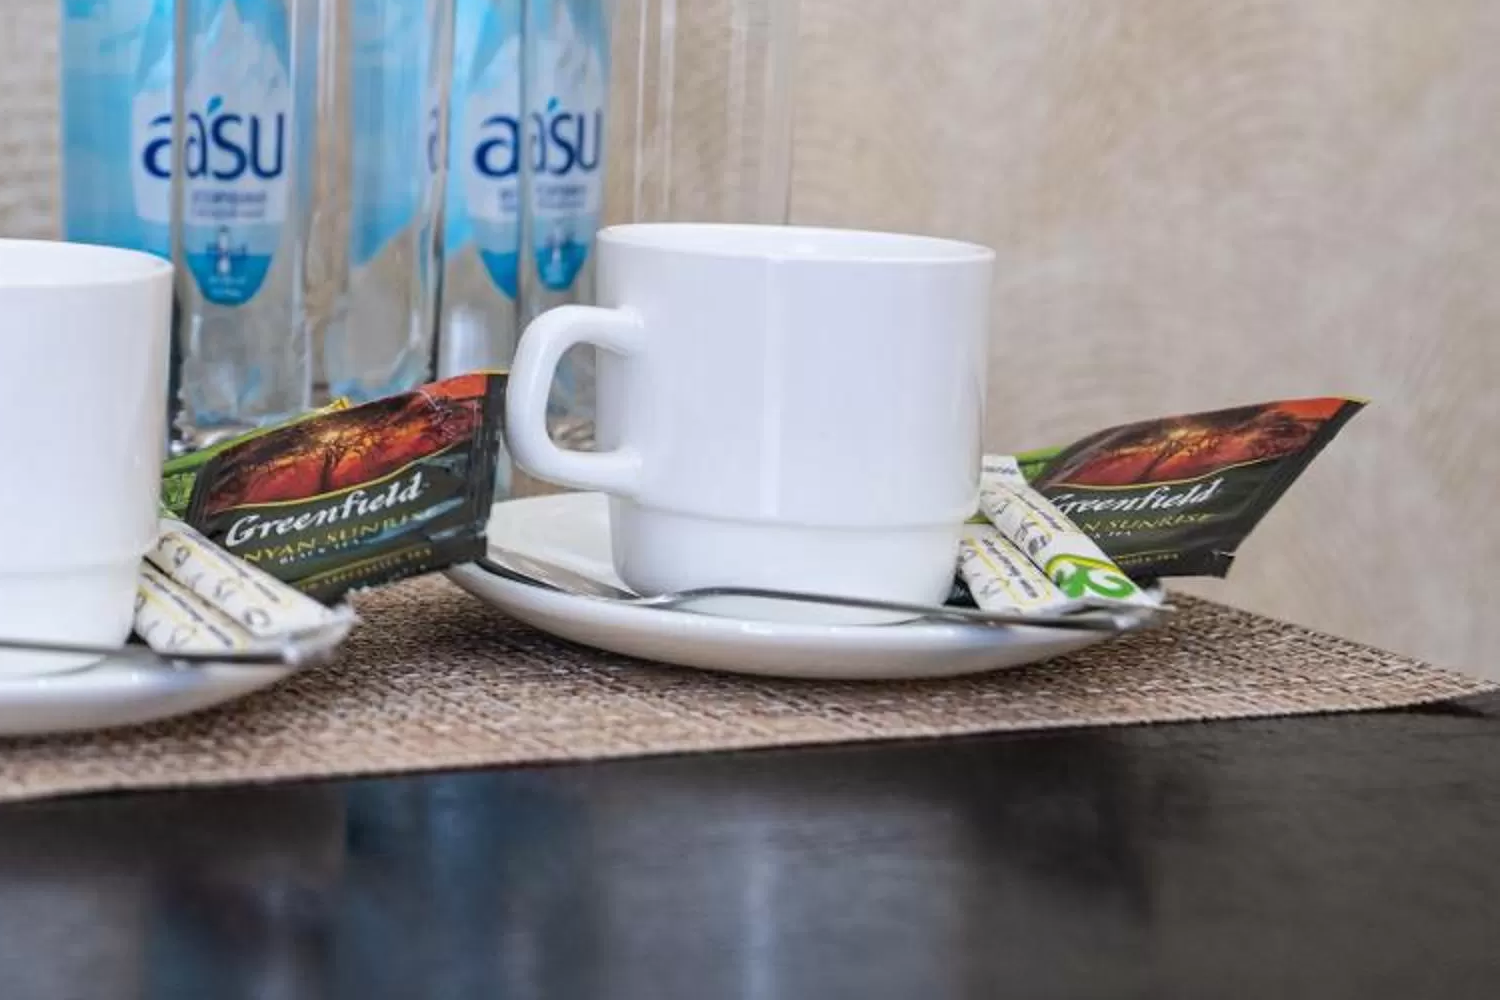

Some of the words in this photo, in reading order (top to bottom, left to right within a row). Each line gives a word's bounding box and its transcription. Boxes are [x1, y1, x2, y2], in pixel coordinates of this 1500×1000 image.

[225, 471, 423, 547] Greenfield
[1051, 477, 1225, 516] Greenfield
[244, 536, 317, 562] NYAN
